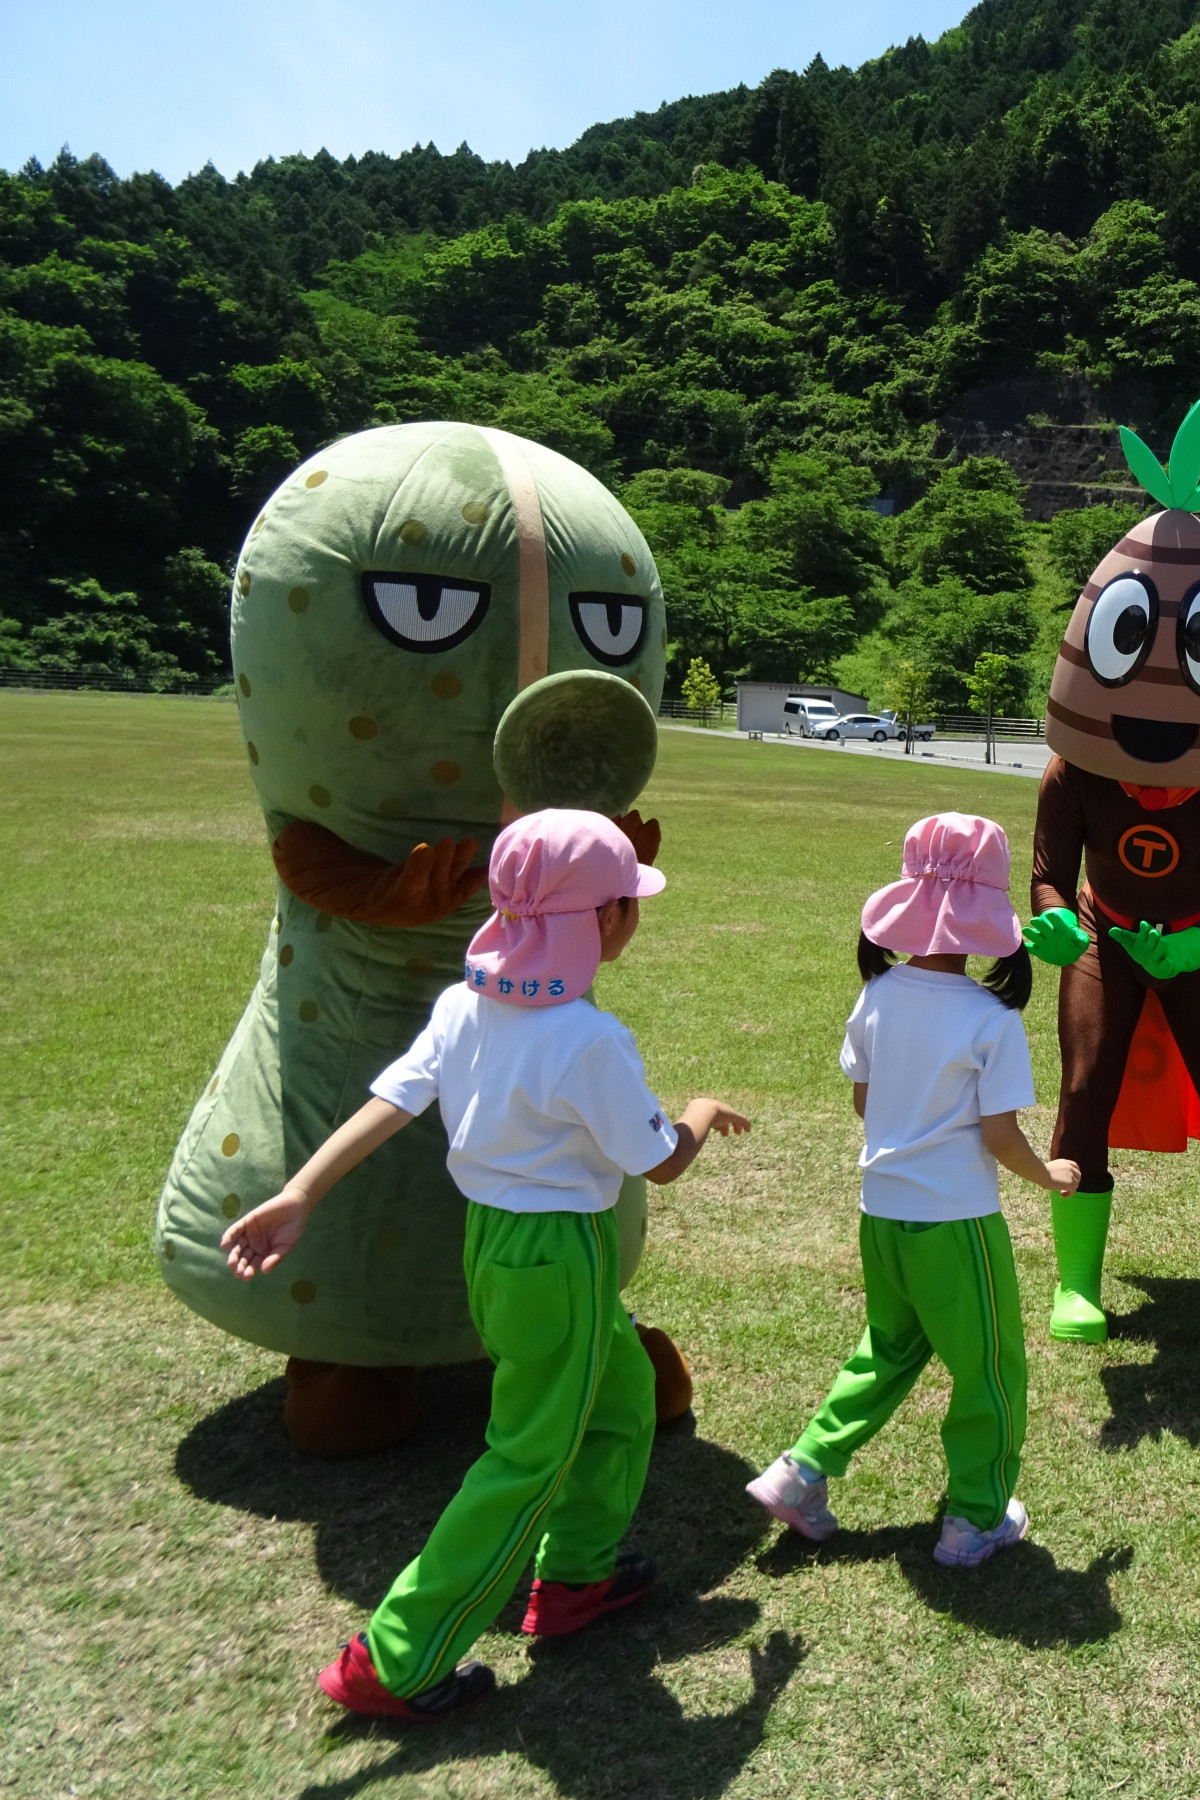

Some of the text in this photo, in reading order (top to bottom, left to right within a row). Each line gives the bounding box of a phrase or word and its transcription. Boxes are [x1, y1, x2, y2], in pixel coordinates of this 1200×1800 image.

[1132, 837, 1167, 868] T
[498, 977, 565, 997] かける
